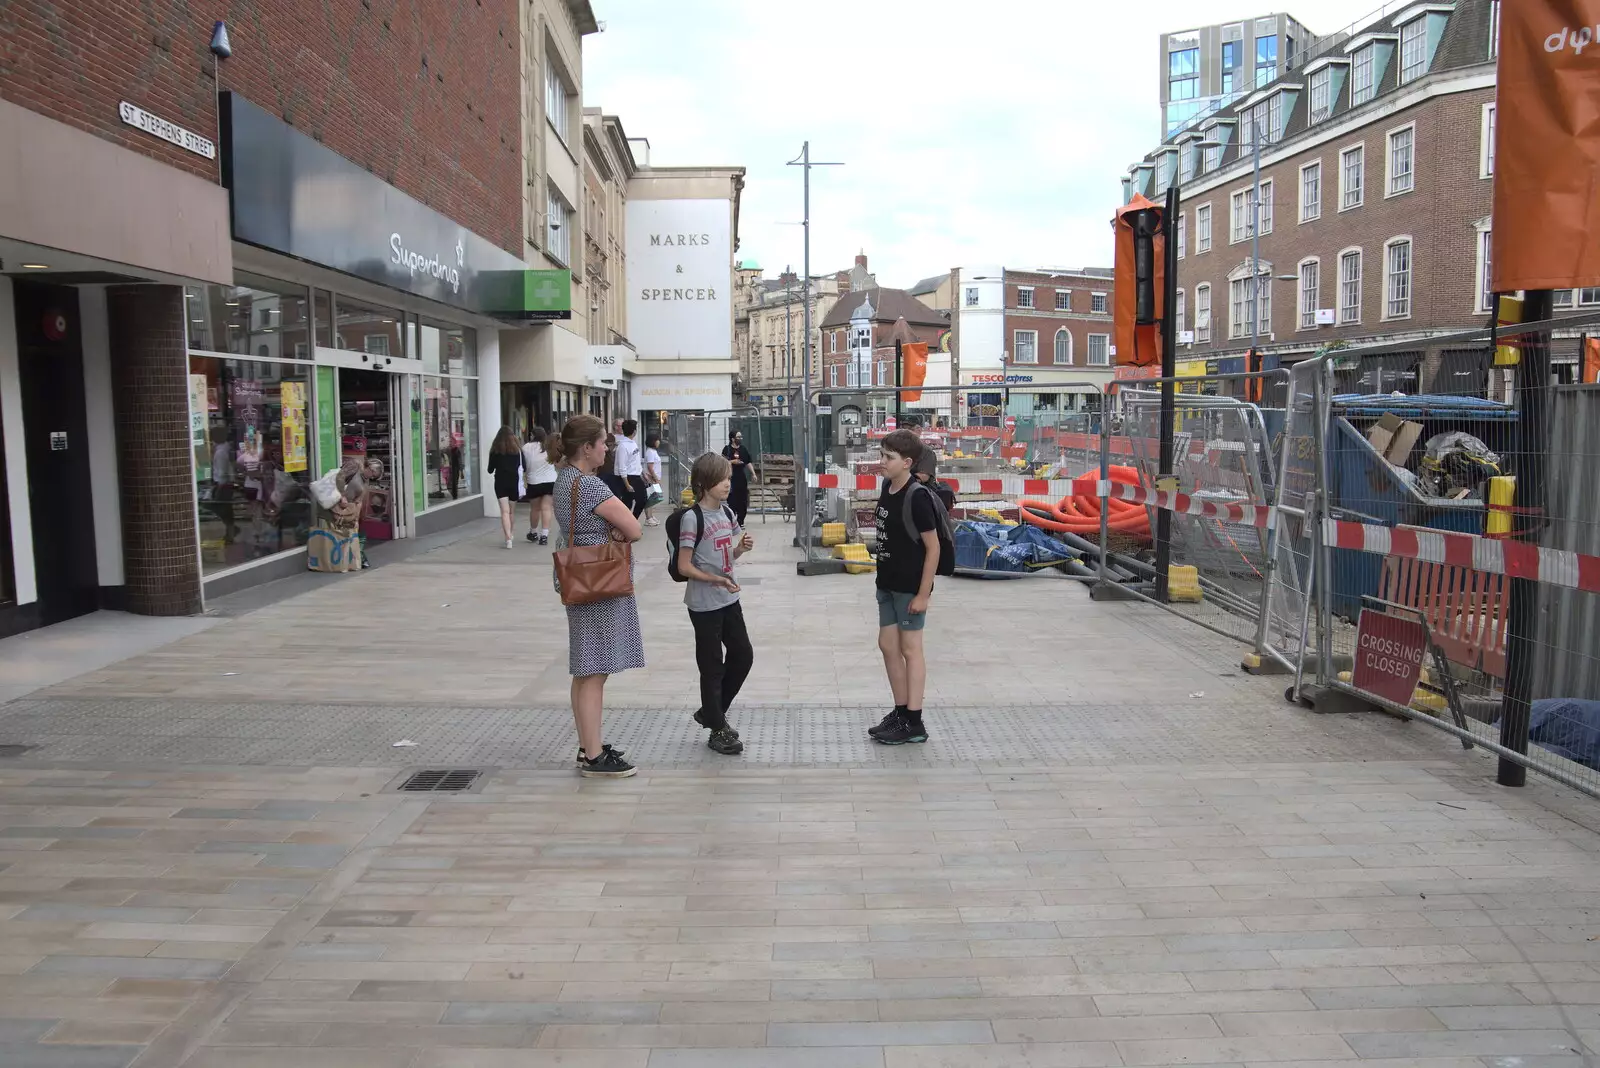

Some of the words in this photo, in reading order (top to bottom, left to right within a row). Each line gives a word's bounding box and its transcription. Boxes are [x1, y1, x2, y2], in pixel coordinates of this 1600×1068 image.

[140, 112, 181, 143] STEPHENS
[185, 132, 213, 157] STREET
[650, 234, 710, 246] MARKS
[390, 232, 460, 294] Superdrug
[676, 264, 683, 273] &
[641, 288, 717, 301] SPENCER
[593, 356, 615, 365] M&S
[1006, 375, 1032, 383] express
[714, 533, 733, 573] T
[1361, 633, 1422, 664] CROSSING
[1366, 653, 1410, 679] CLOSED
